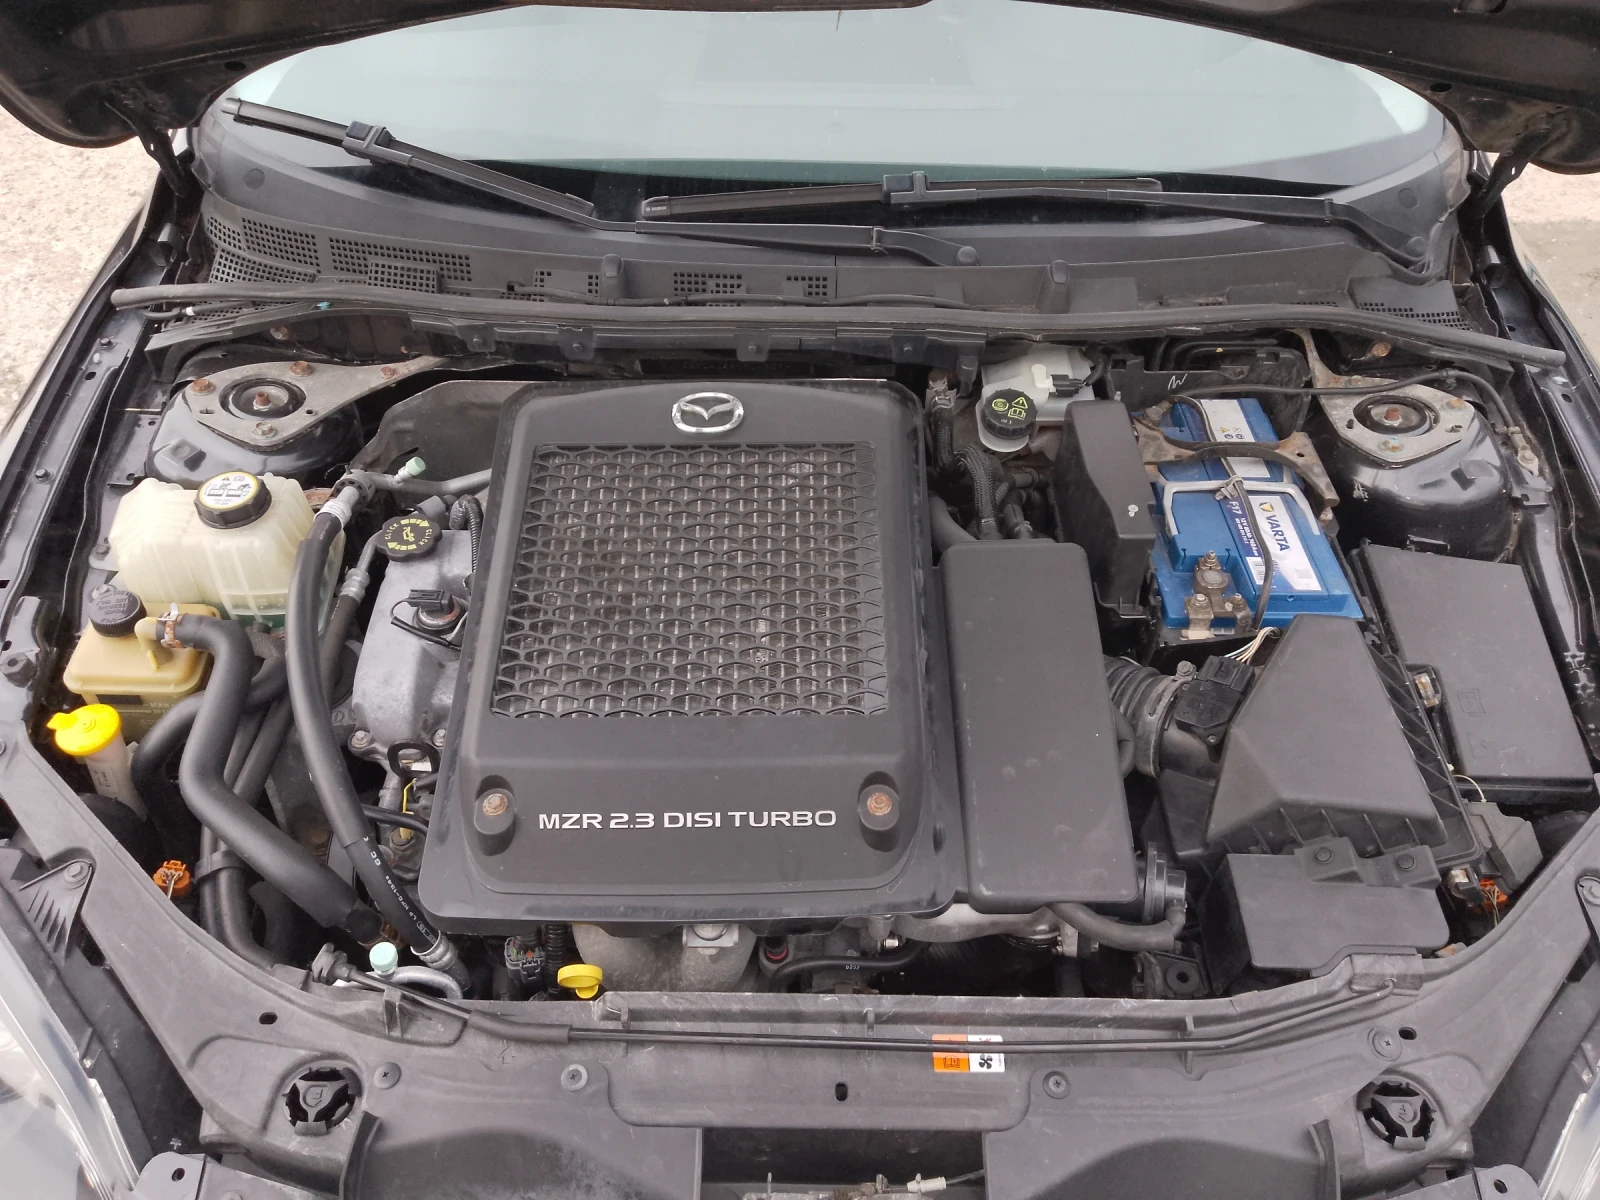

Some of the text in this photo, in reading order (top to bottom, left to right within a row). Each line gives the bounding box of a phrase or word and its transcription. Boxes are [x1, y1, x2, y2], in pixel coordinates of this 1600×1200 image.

[384, 523, 399, 540] CLICK
[418, 529, 432, 545] CLICK
[1266, 514, 1291, 552] VARTA
[539, 810, 837, 829] MZR 2.3 DISI TURBO
